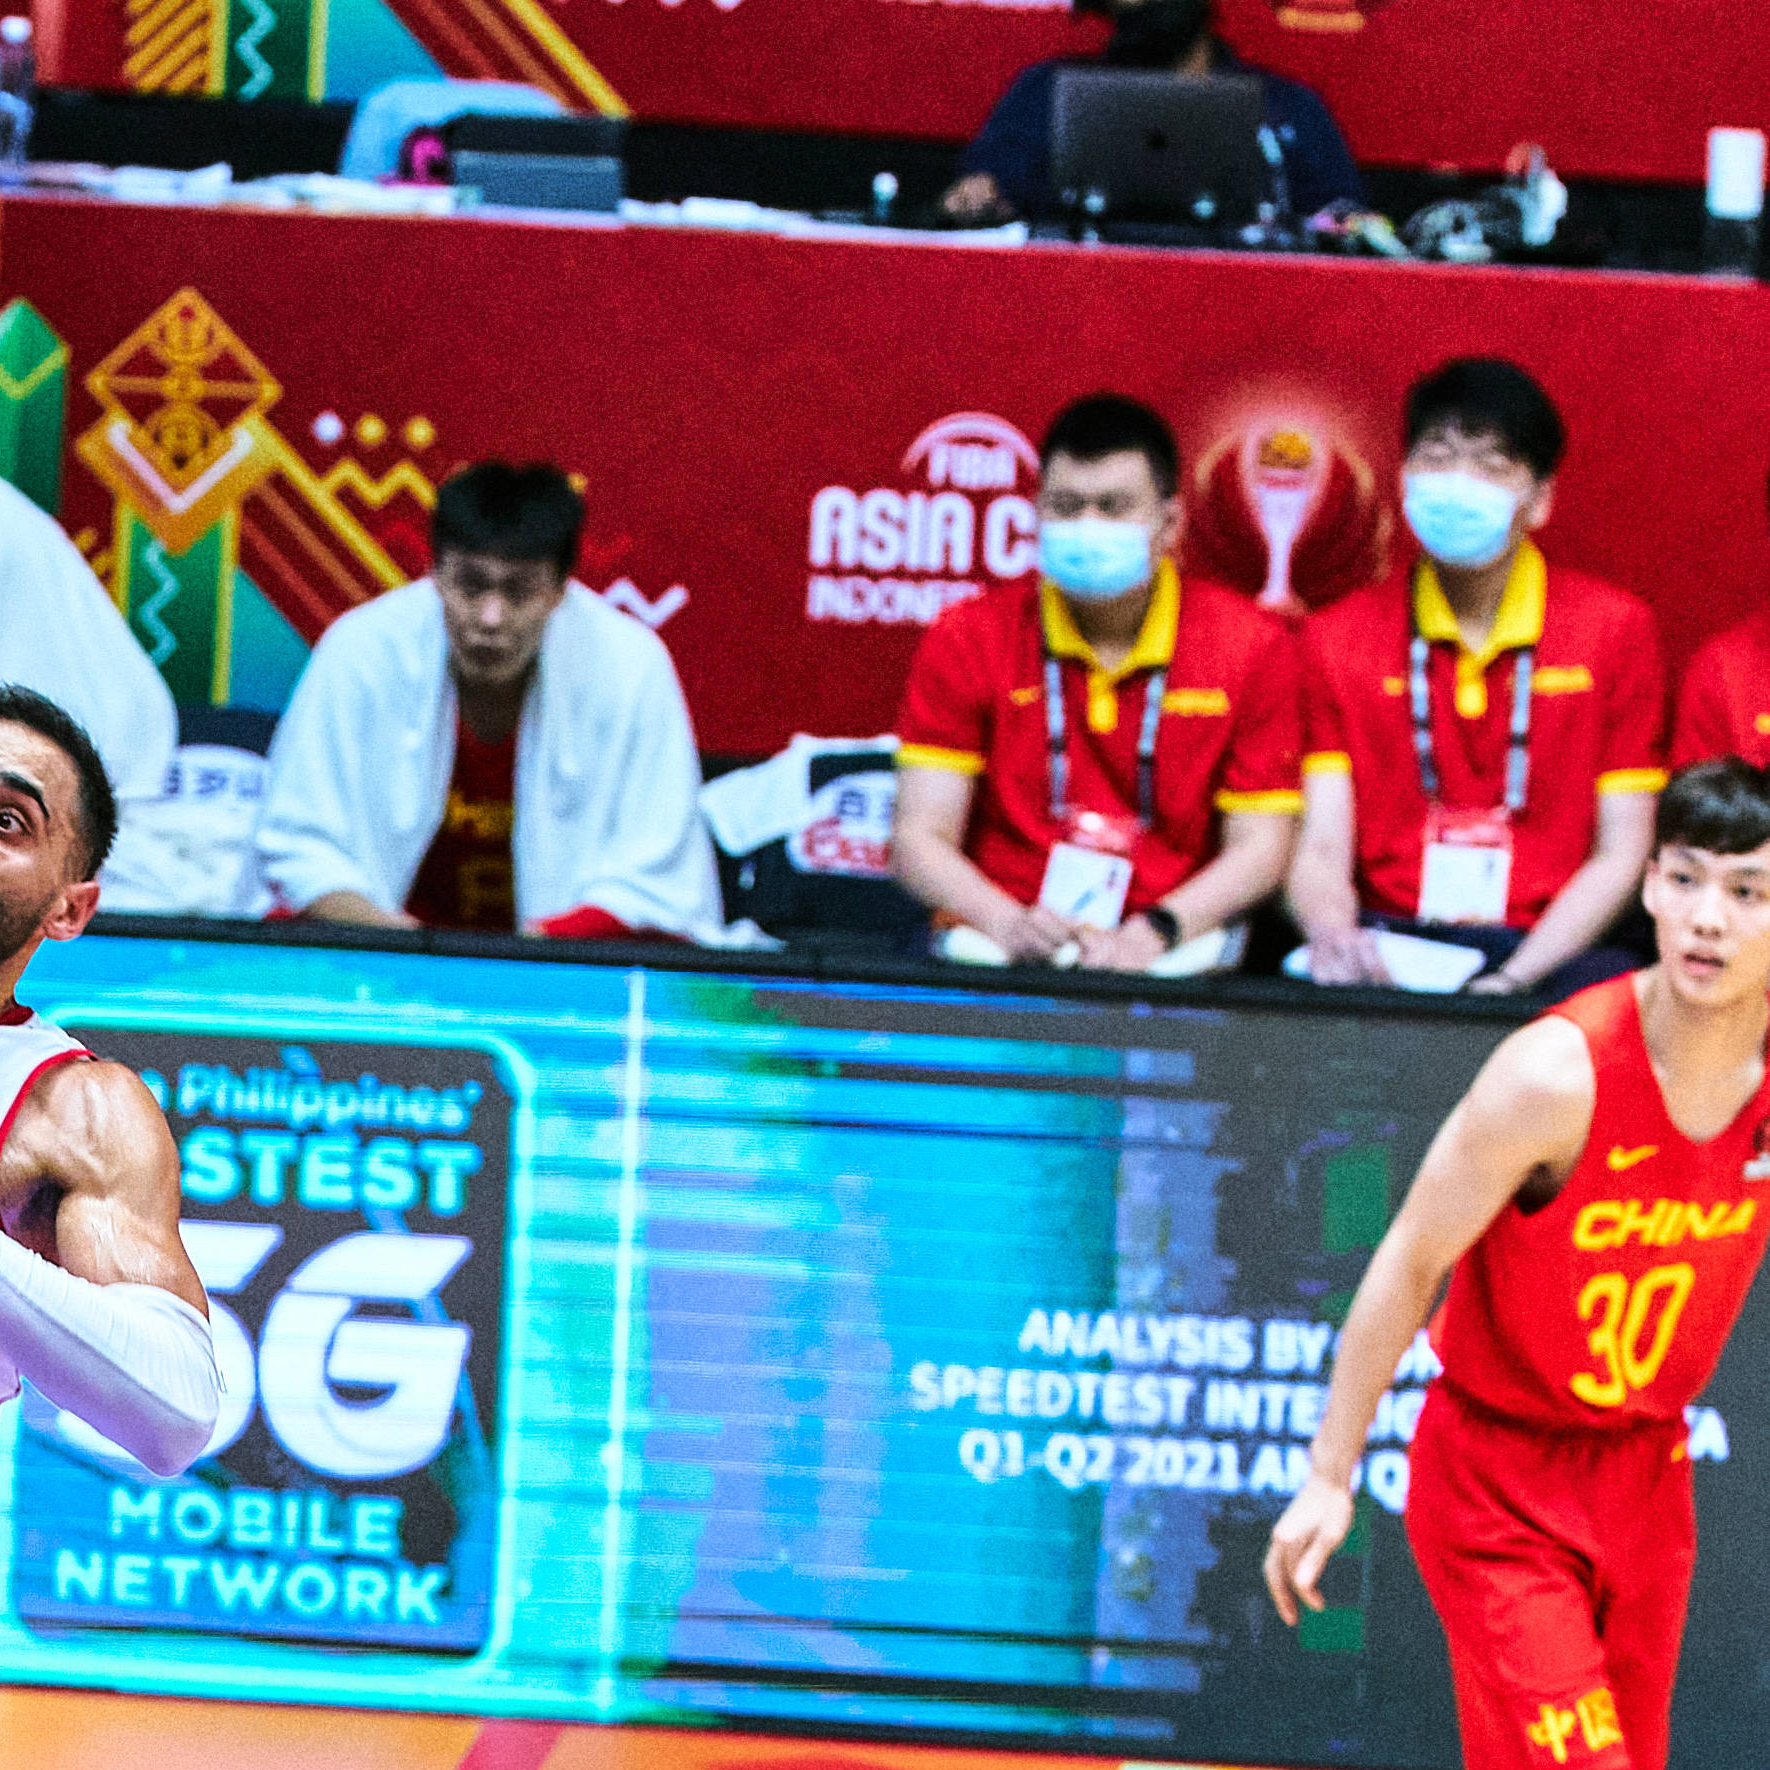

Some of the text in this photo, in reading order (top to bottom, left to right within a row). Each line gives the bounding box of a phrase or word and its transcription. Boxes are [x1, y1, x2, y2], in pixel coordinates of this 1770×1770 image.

[810, 484, 974, 574] ASIA
[179, 1124, 484, 1217] STEST
[1572, 1197, 1757, 1250] CHINA
[1017, 1307, 1255, 1374] ANALYSIS
[1262, 1316, 1330, 1375] BY
[1569, 1262, 1695, 1407] 30
[907, 1360, 1194, 1426] SPEEDTEST
[1123, 1438, 1241, 1493] 2021
[107, 1484, 404, 1558] MOBILE
[53, 1546, 451, 1626] NETWORK
